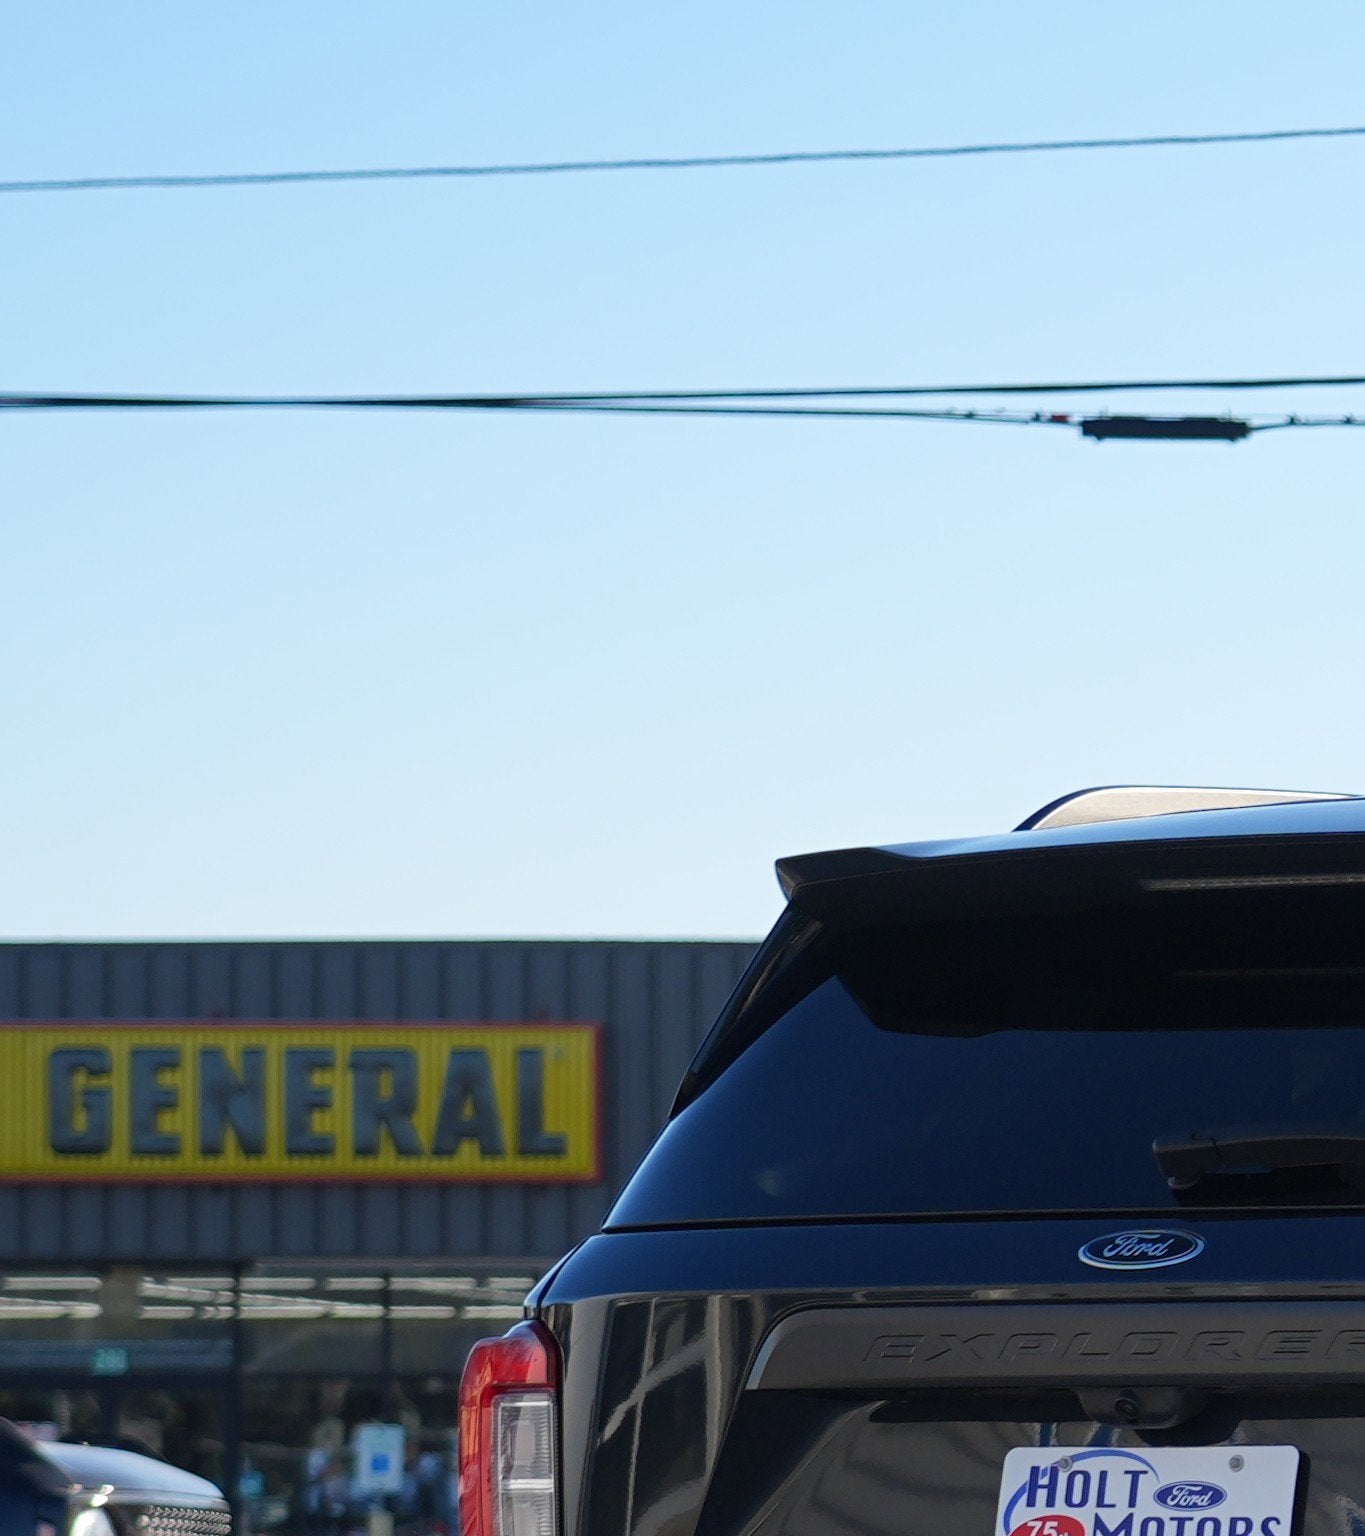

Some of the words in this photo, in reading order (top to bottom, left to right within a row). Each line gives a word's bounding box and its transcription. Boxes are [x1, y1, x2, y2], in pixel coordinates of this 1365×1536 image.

[48, 1044, 569, 1157] GENERAL
[1100, 1231, 1178, 1258] Ford
[1026, 1465, 1150, 1509] HOLT
[1164, 1484, 1215, 1507] Ford
